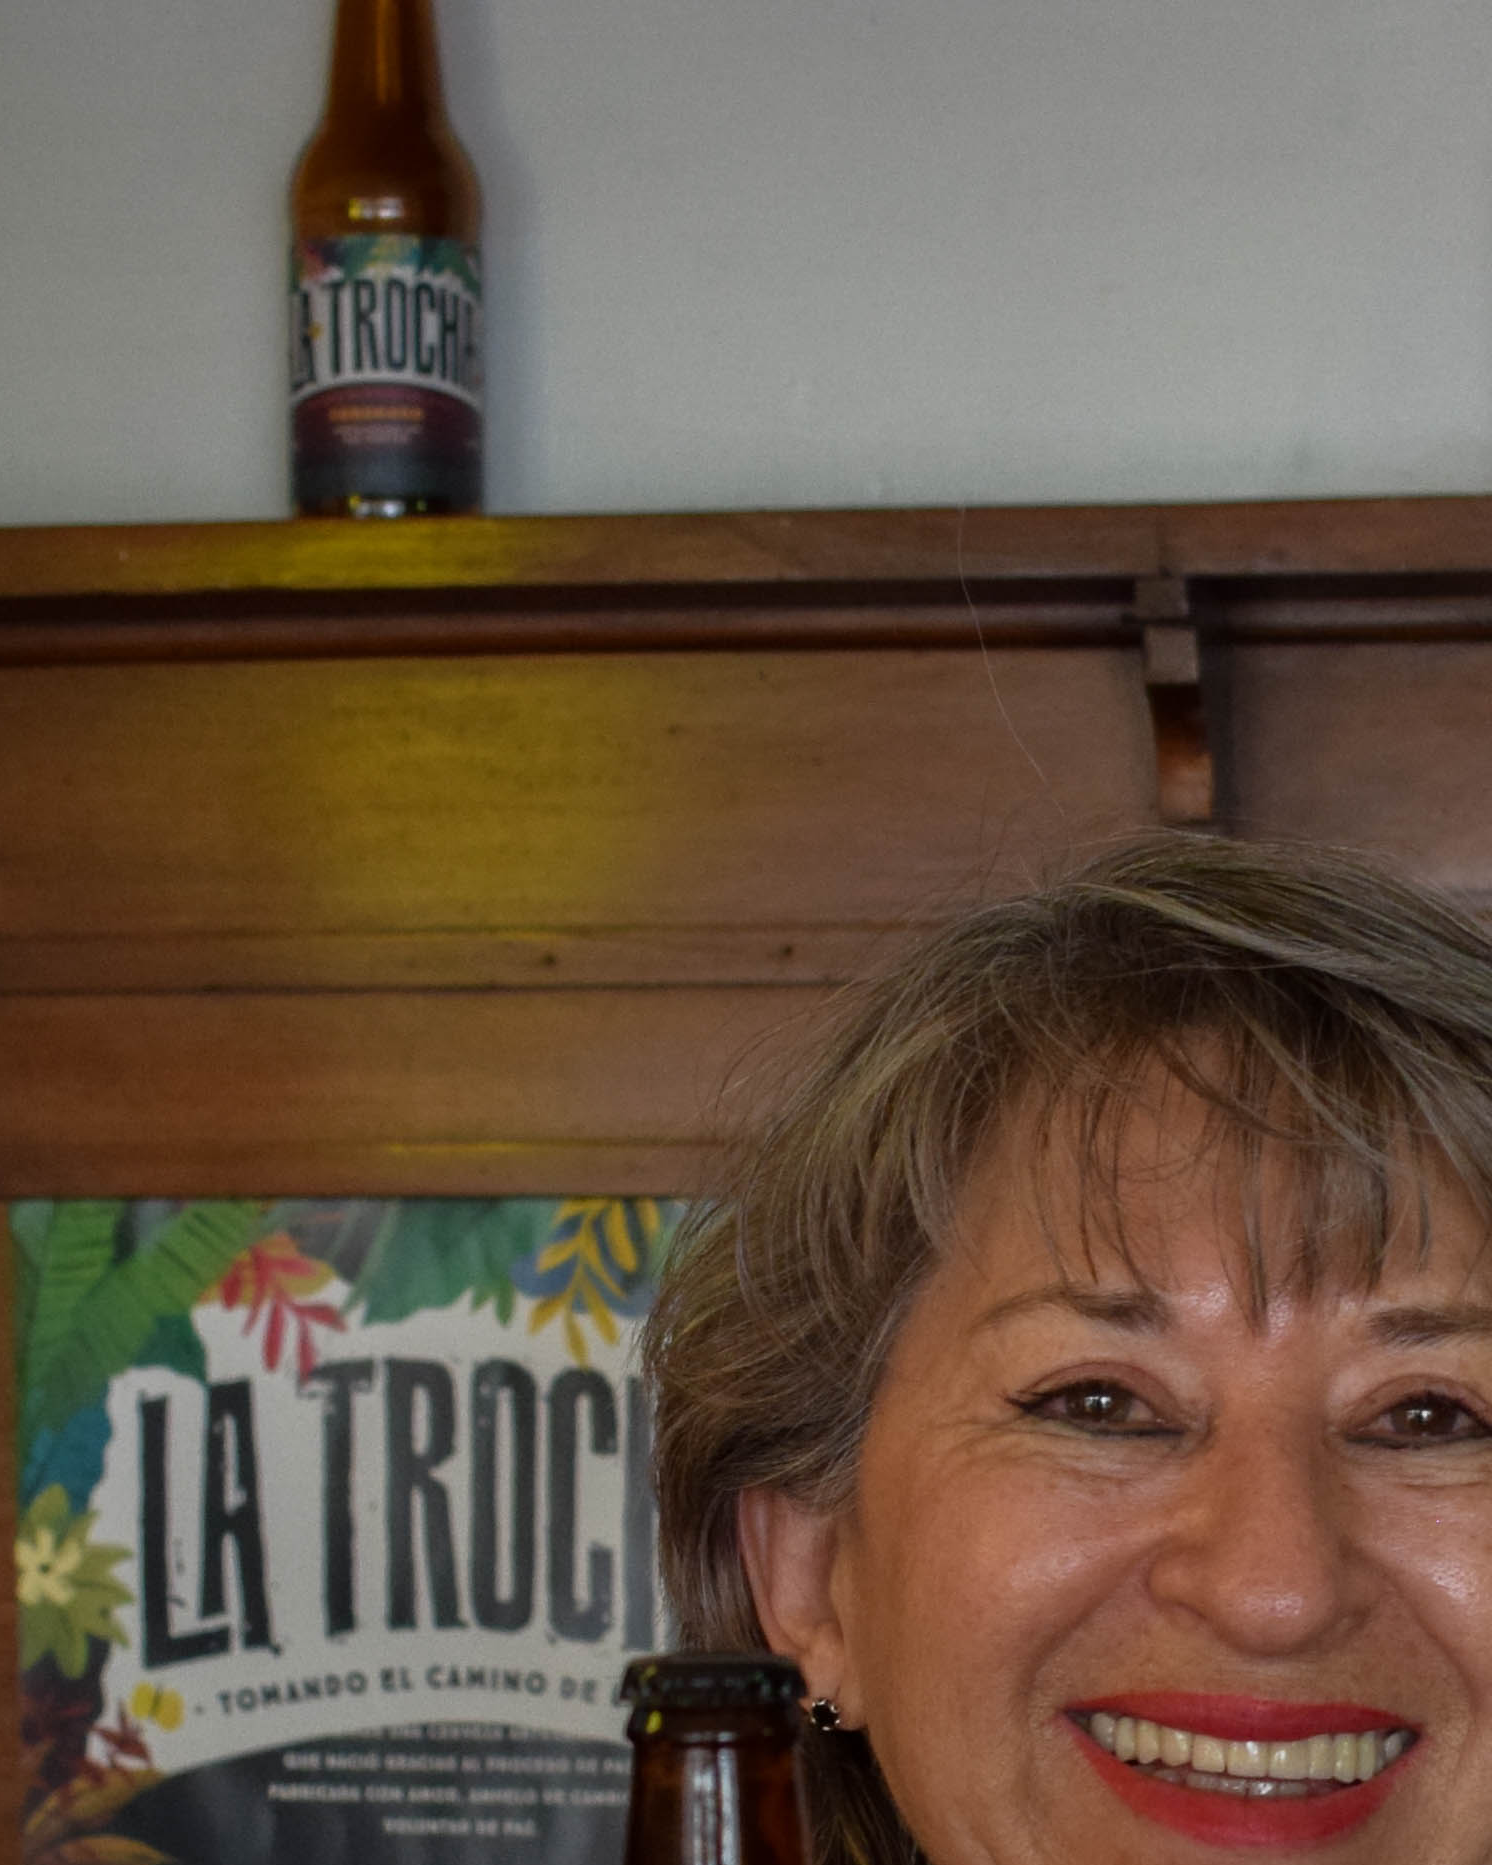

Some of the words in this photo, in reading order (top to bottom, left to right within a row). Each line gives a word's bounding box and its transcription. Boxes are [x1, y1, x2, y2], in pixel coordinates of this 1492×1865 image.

[137, 1377, 278, 1669] LA
[217, 1670, 369, 1715] TOMANDO
[380, 1667, 415, 1693] EL
[425, 1664, 547, 1696] CAMINO
[559, 1676, 599, 1706] DE
